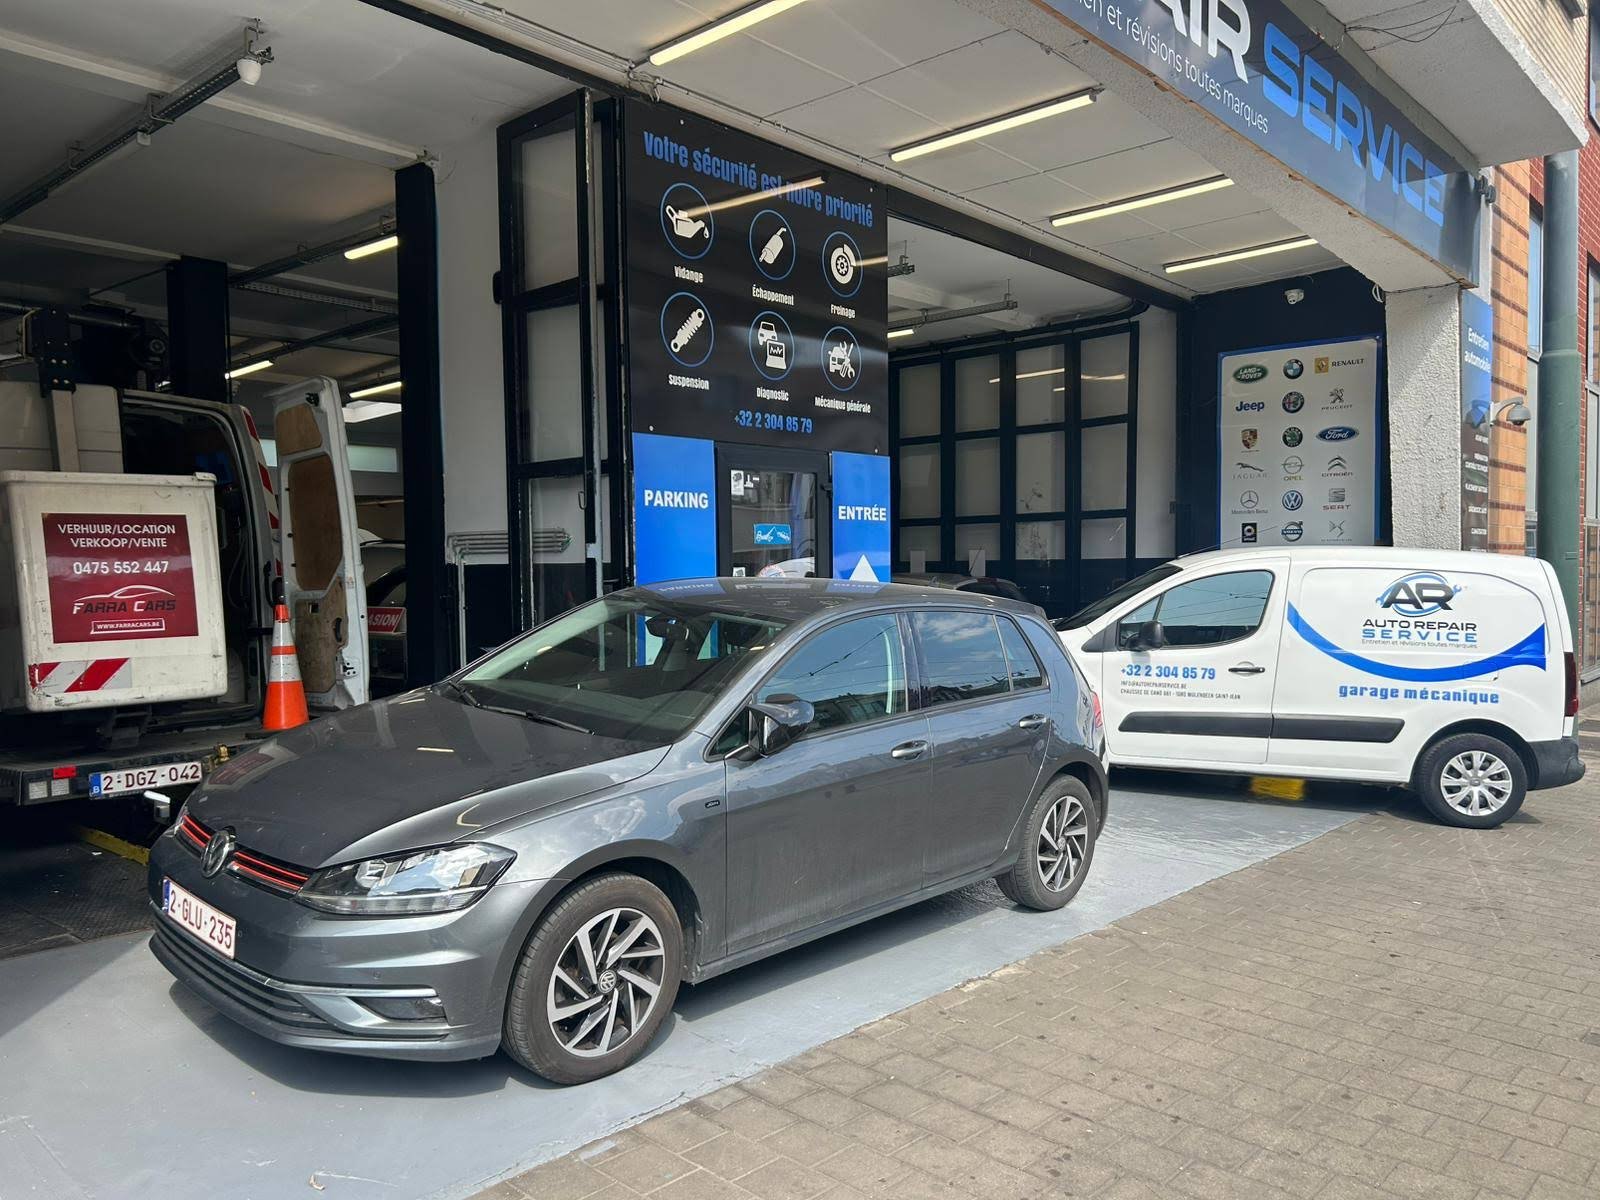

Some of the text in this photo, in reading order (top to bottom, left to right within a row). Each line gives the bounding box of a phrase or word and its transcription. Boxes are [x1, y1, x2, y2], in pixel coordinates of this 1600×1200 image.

[1107, 5, 1122, 31] et
[1126, 17, 1182, 72] révisions
[1184, 59, 1221, 100] toutes
[1223, 90, 1269, 134] marques
[1262, 21, 1446, 227] SERVICE
[643, 131, 873, 228] Votre sécurité est notre priorité
[674, 265, 704, 283] Vidange
[752, 284, 794, 306] Échappement
[830, 304, 856, 319] Freinage
[1331, 358, 1365, 368] RENAULT
[668, 374, 710, 391] Suspension
[756, 387, 789, 402] Diagnostic
[814, 395, 871, 414] Mécanique générale
[1235, 401, 1265, 412] Jeep
[734, 410, 813, 434] +32 2 304 85 79
[1325, 429, 1349, 440] Ford
[1232, 472, 1268, 480] JAGUAR
[644, 489, 709, 509] PARKING
[838, 504, 887, 522] ENTRÉE
[57, 523, 176, 535] VERHUUR/LOCATION
[70, 537, 168, 549] VERKOOP/VENTE
[73, 560, 169, 575] 0475 552 447
[1381, 582, 1455, 610] AR
[72, 600, 177, 615] FARRA CARS
[96, 621, 161, 630] WWW.FARRACARS.BE
[1363, 618, 1477, 631] AUTO REPAIR
[1362, 628, 1478, 643] SERVICE
[1121, 664, 1216, 680] +32 2 304 85 79
[1339, 685, 1499, 704] garage mécanique
[103, 764, 200, 791] 2-DGZ-042
[93, 785, 100, 794] B
[169, 889, 233, 950] 2-GLU-235
